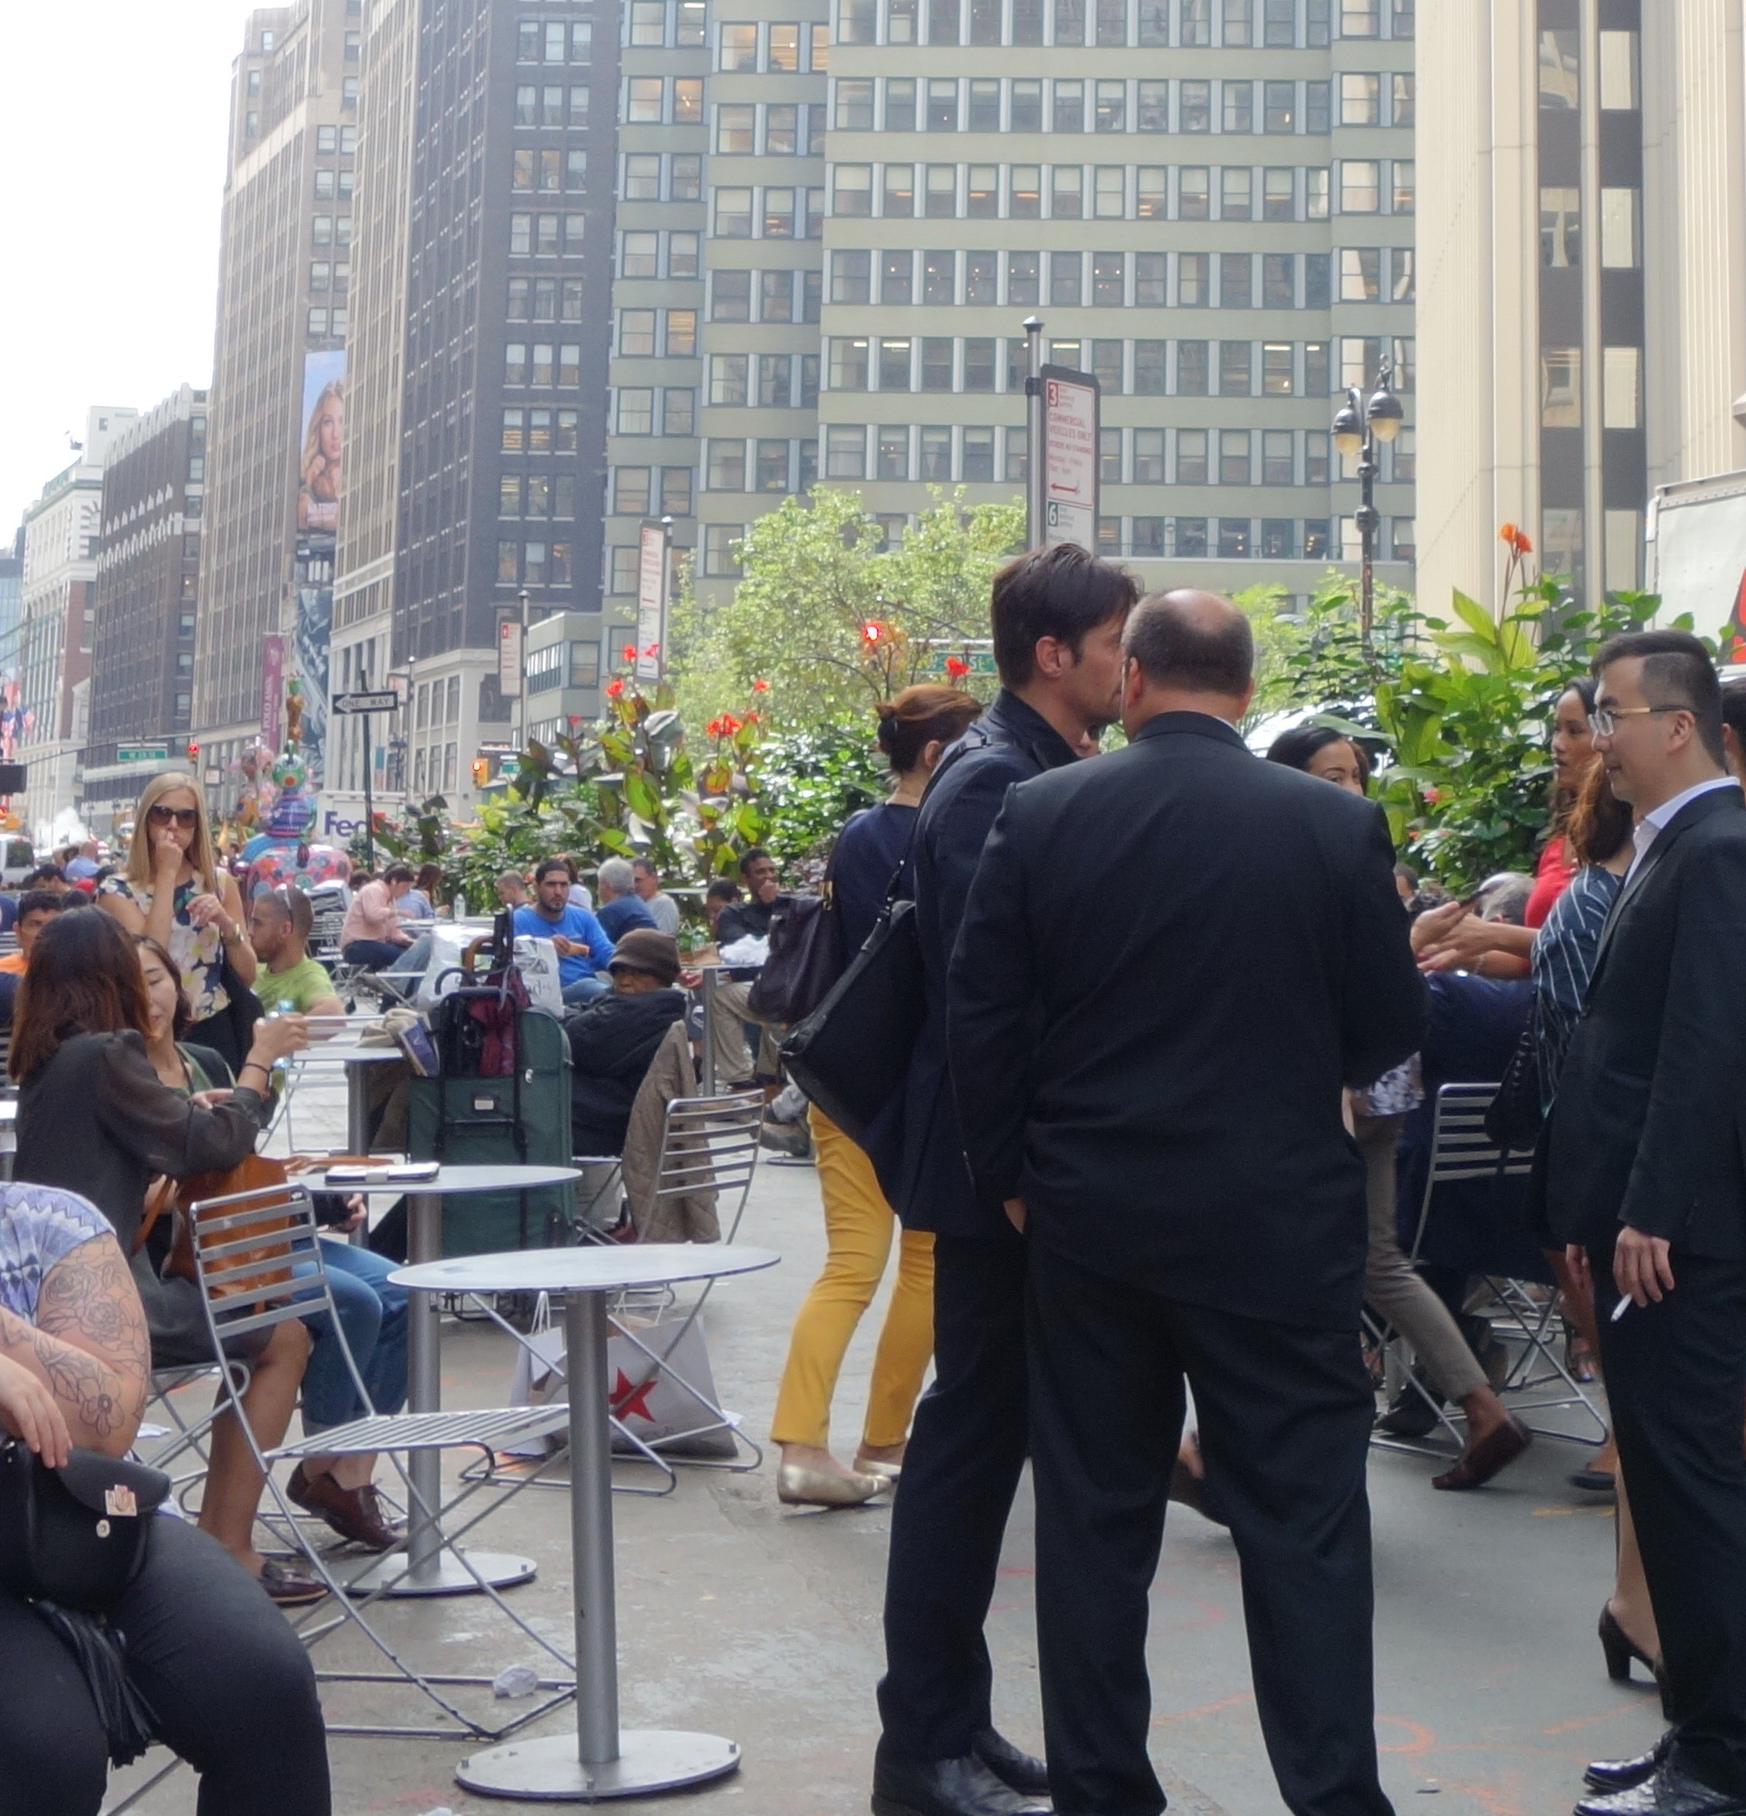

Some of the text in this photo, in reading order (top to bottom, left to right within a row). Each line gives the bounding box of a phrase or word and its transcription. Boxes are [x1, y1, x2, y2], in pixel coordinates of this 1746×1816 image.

[1049, 383, 1058, 407] 3
[1048, 503, 1058, 526] 6
[341, 698, 391, 709] ONE WAY
